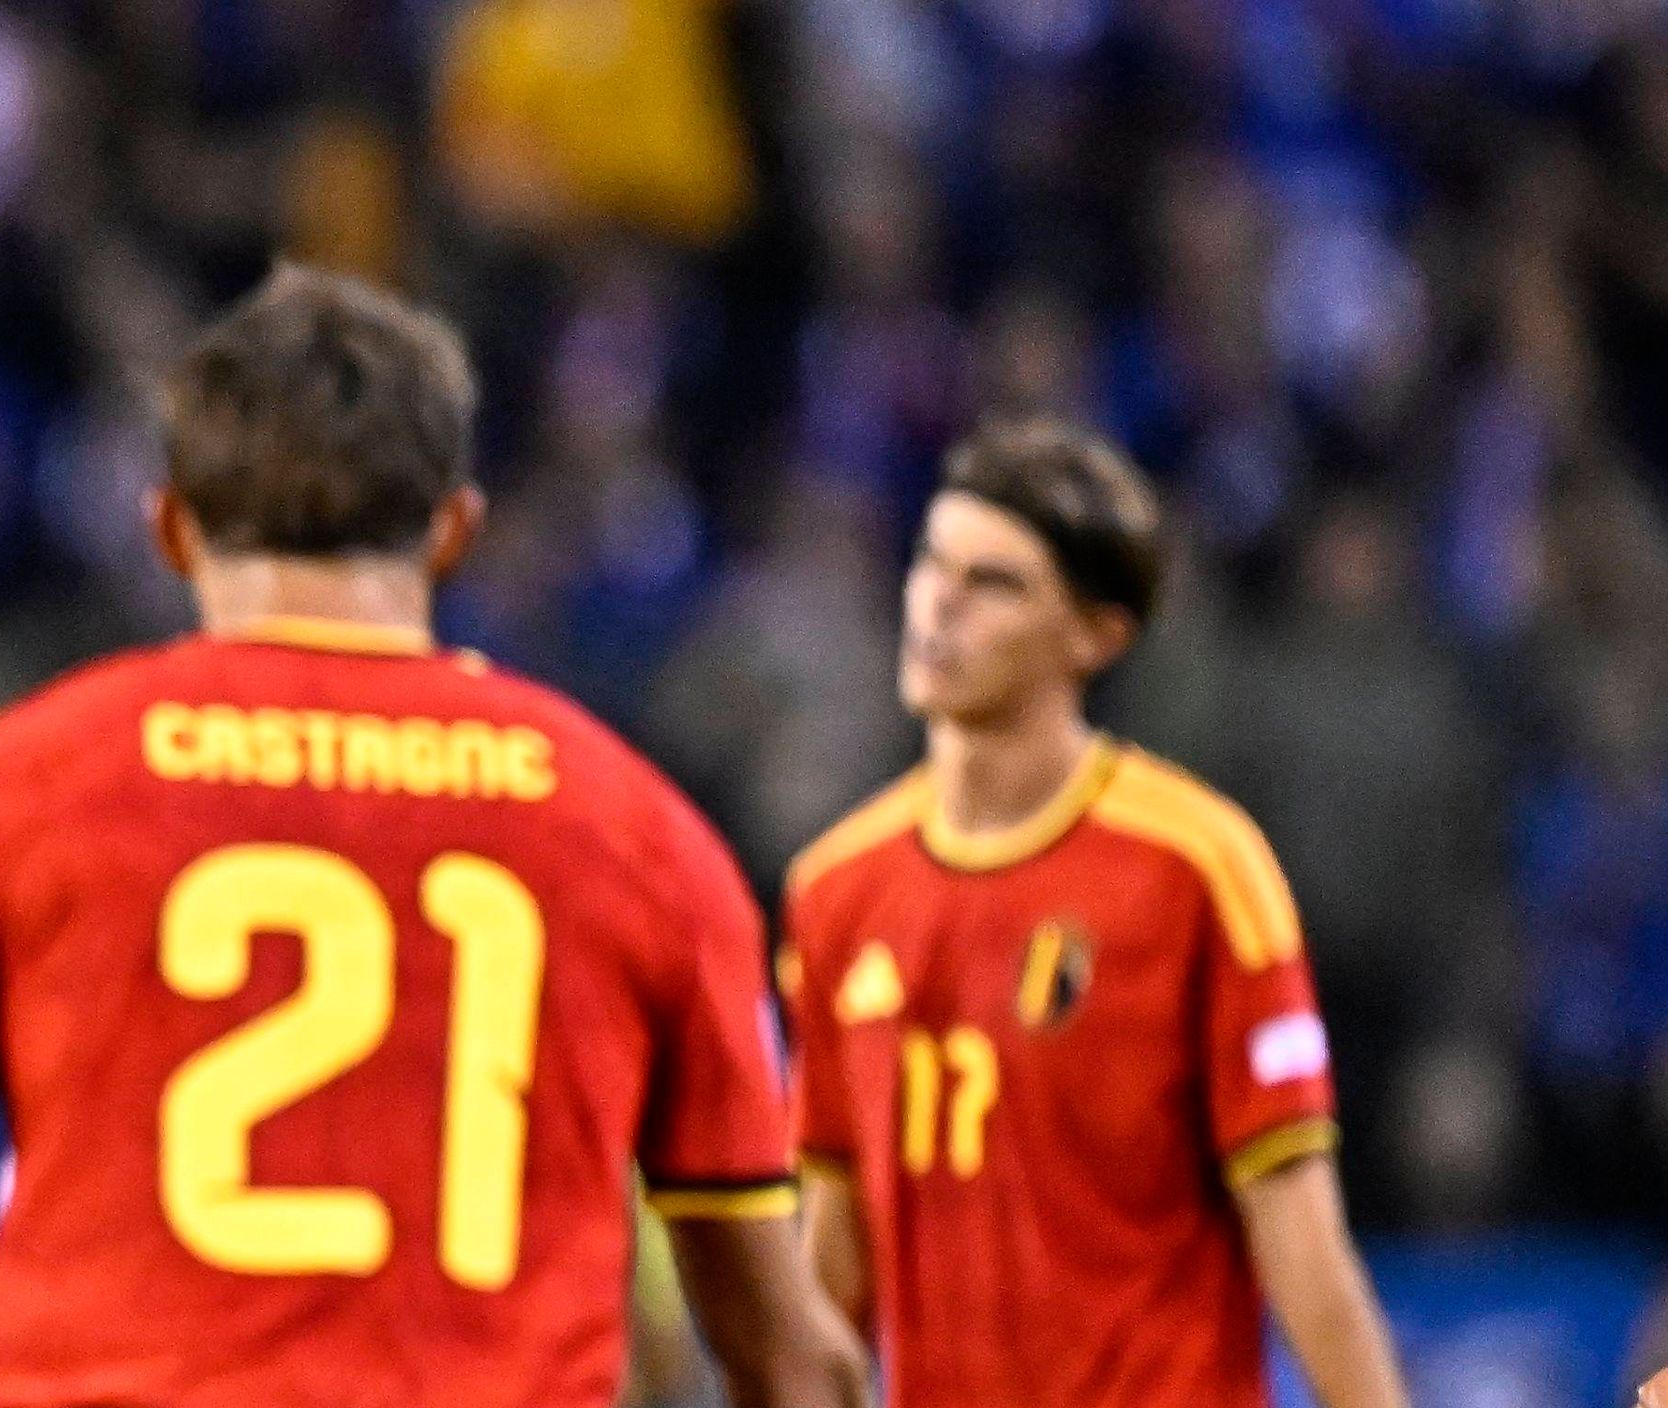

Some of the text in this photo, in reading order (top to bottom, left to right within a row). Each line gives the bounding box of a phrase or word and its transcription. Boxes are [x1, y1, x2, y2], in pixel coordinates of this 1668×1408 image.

[141, 701, 558, 801] CASTAGNE
[159, 842, 546, 1292] 21
[902, 1027, 1000, 1181] 17
